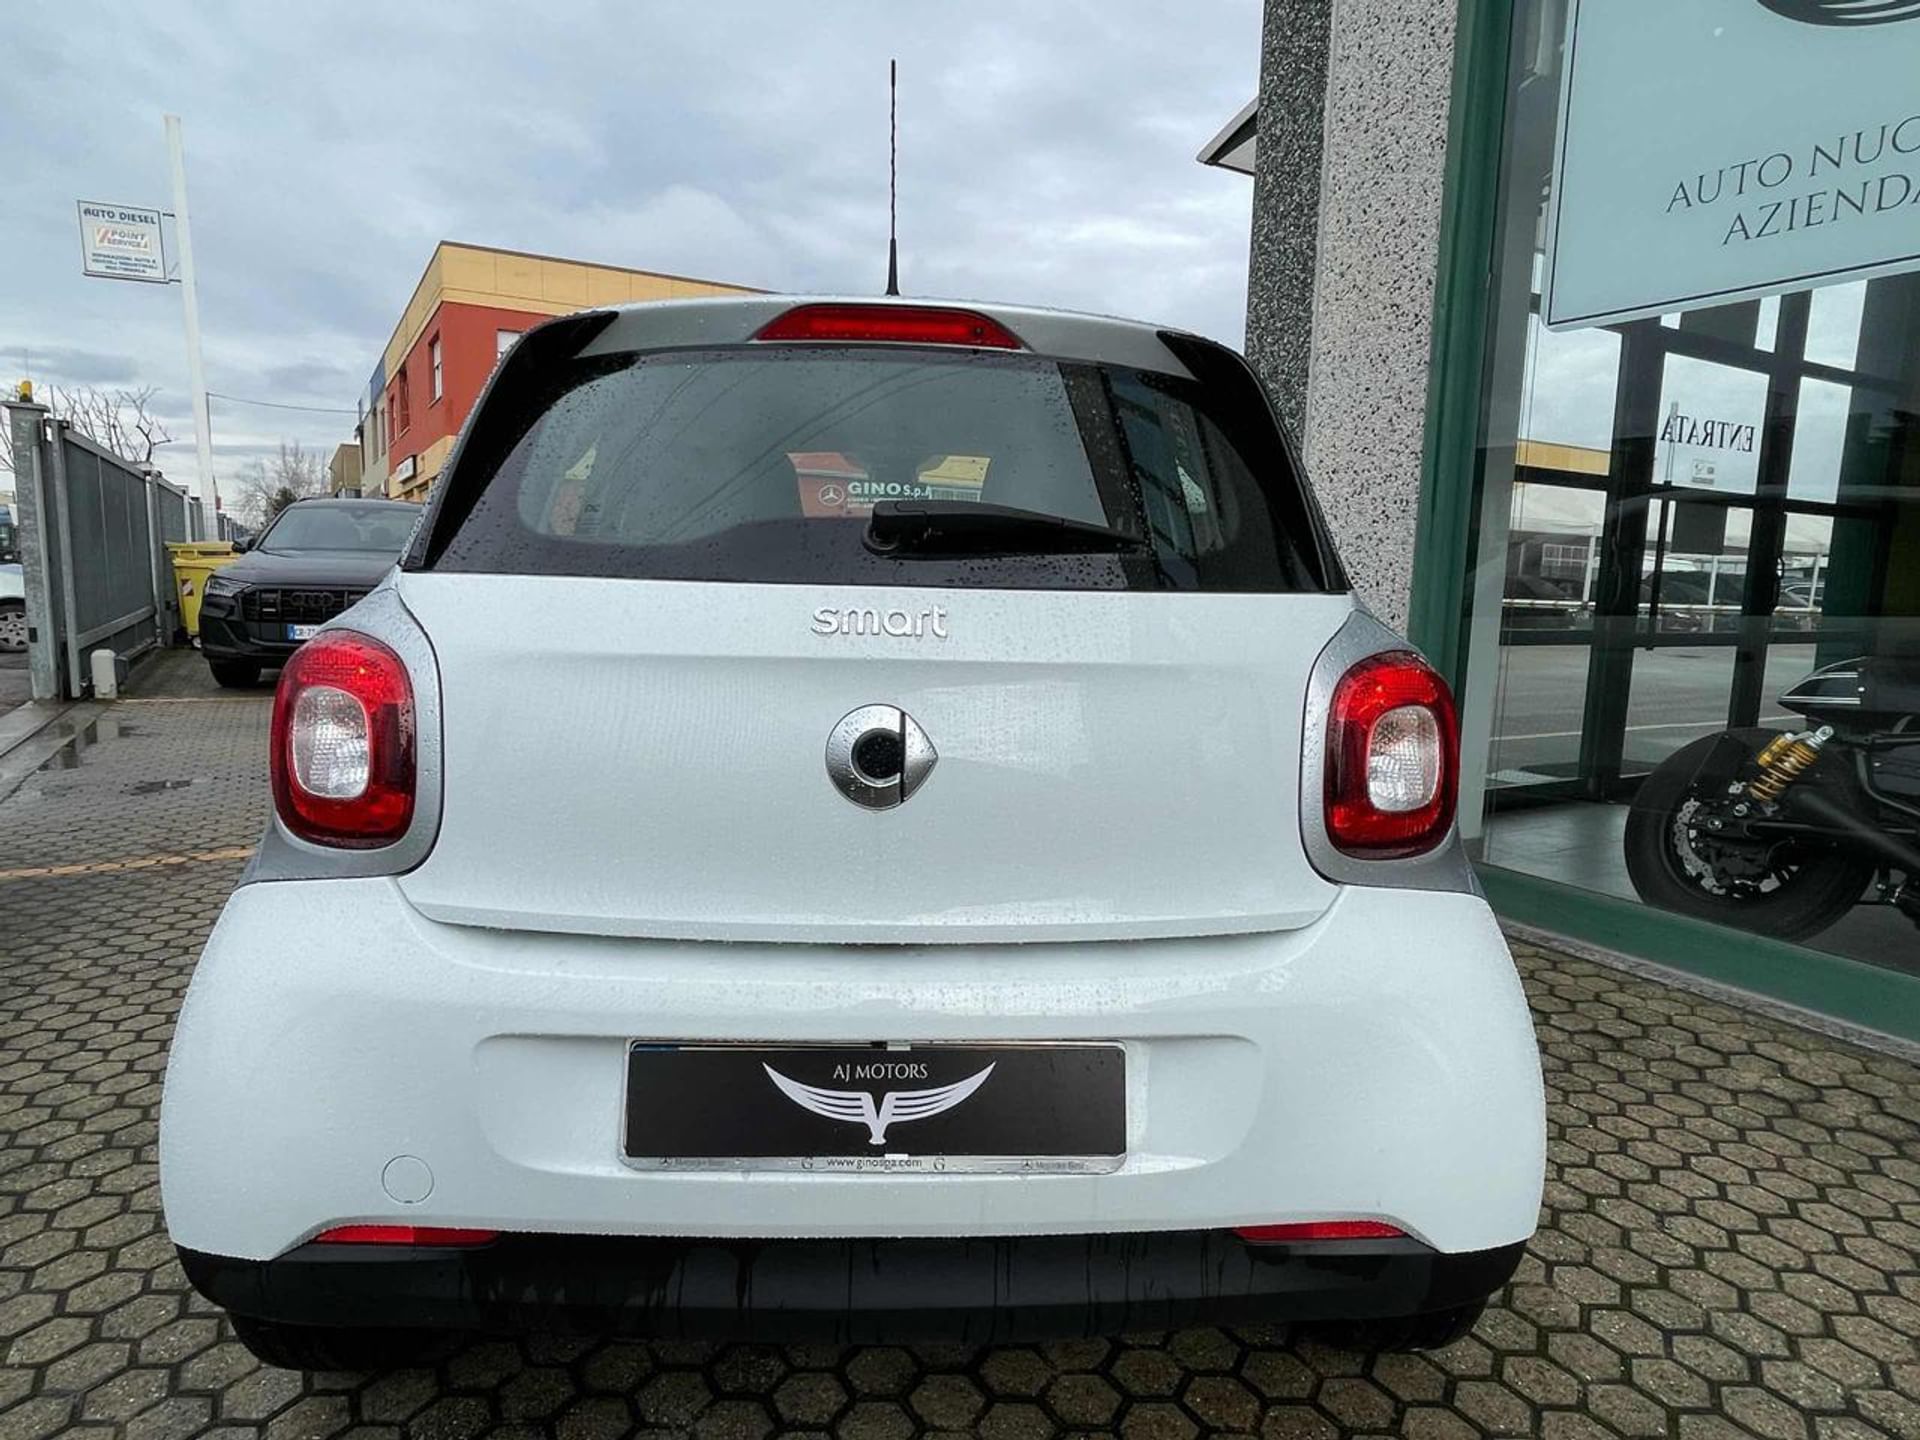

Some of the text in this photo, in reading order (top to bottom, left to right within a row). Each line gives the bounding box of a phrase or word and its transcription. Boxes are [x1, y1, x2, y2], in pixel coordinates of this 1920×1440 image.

[1666, 153, 1793, 213] AUTO
[84, 208, 115, 219] AUTO
[119, 211, 156, 224] DIESEL
[1722, 174, 1920, 246] AZIEND
[111, 229, 145, 241] POINT
[847, 481, 902, 496] GINO
[811, 604, 948, 638] smart
[833, 1063, 929, 1083] AJ MOTORS
